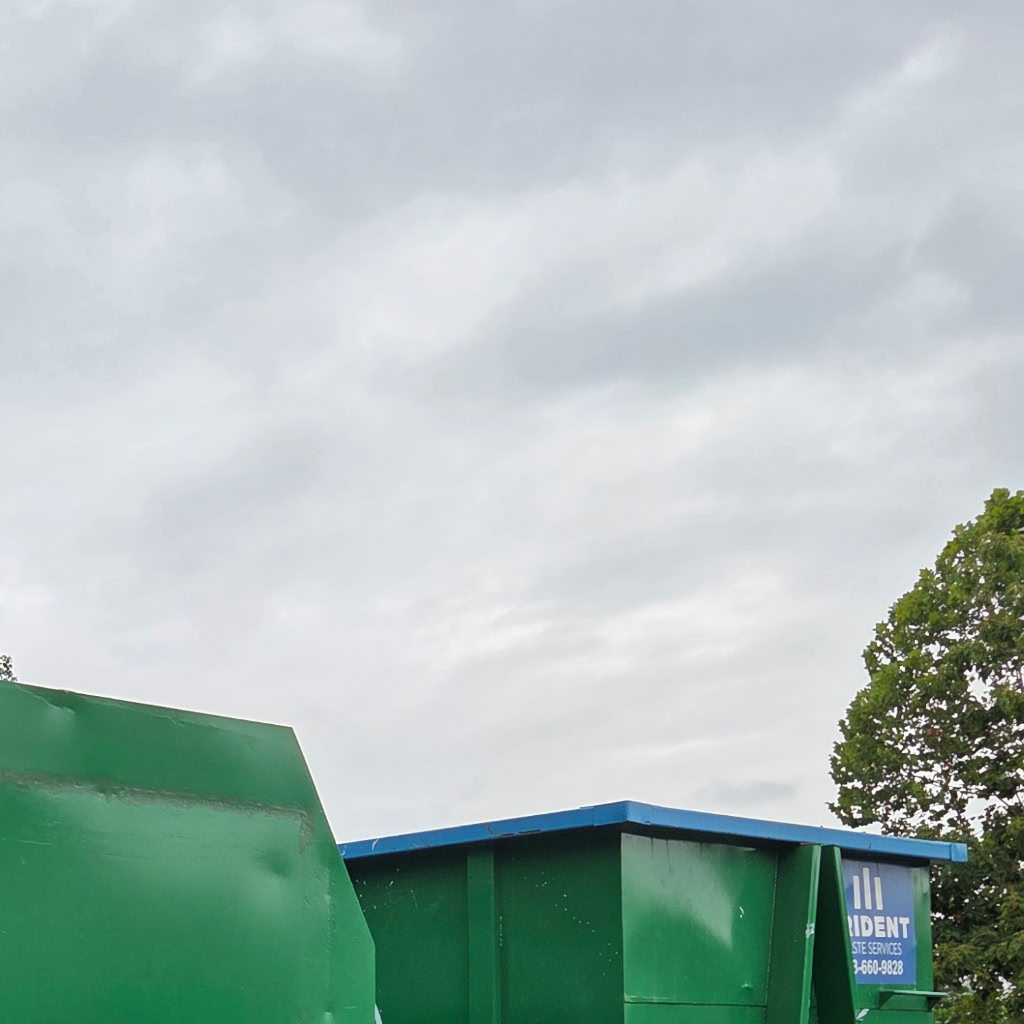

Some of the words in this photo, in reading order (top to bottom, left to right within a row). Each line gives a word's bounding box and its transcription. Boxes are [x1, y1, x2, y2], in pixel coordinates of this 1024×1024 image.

[847, 915, 910, 938] RIDENT
[852, 941, 867, 955] STE
[868, 941, 902, 956] SERVICES
[853, 958, 904, 975] 3-660-9828
